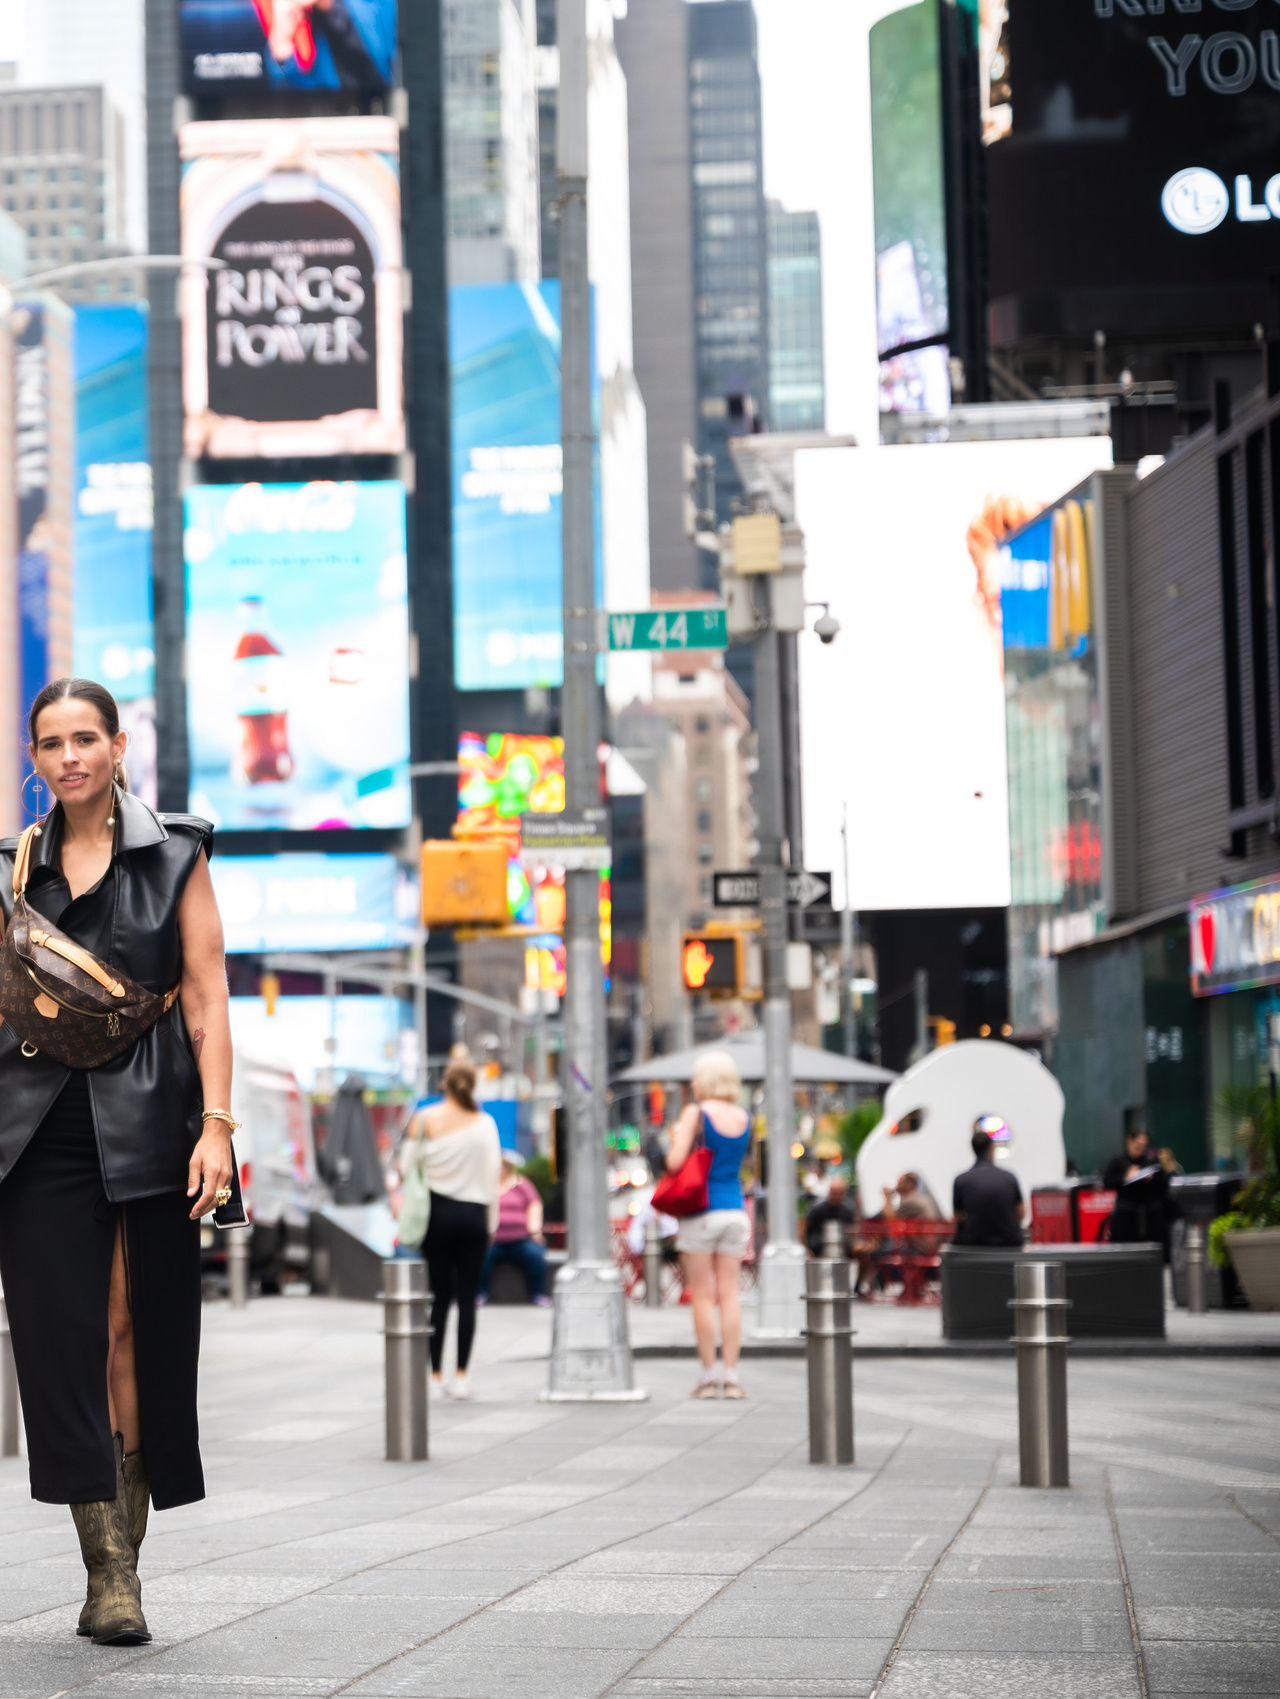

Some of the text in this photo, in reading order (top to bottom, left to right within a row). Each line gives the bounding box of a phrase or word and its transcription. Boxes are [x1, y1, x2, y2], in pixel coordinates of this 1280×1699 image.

[216, 265, 365, 317] RINGS
[216, 316, 369, 368] POWER
[610, 614, 635, 649] W
[648, 612, 688, 648] 44
